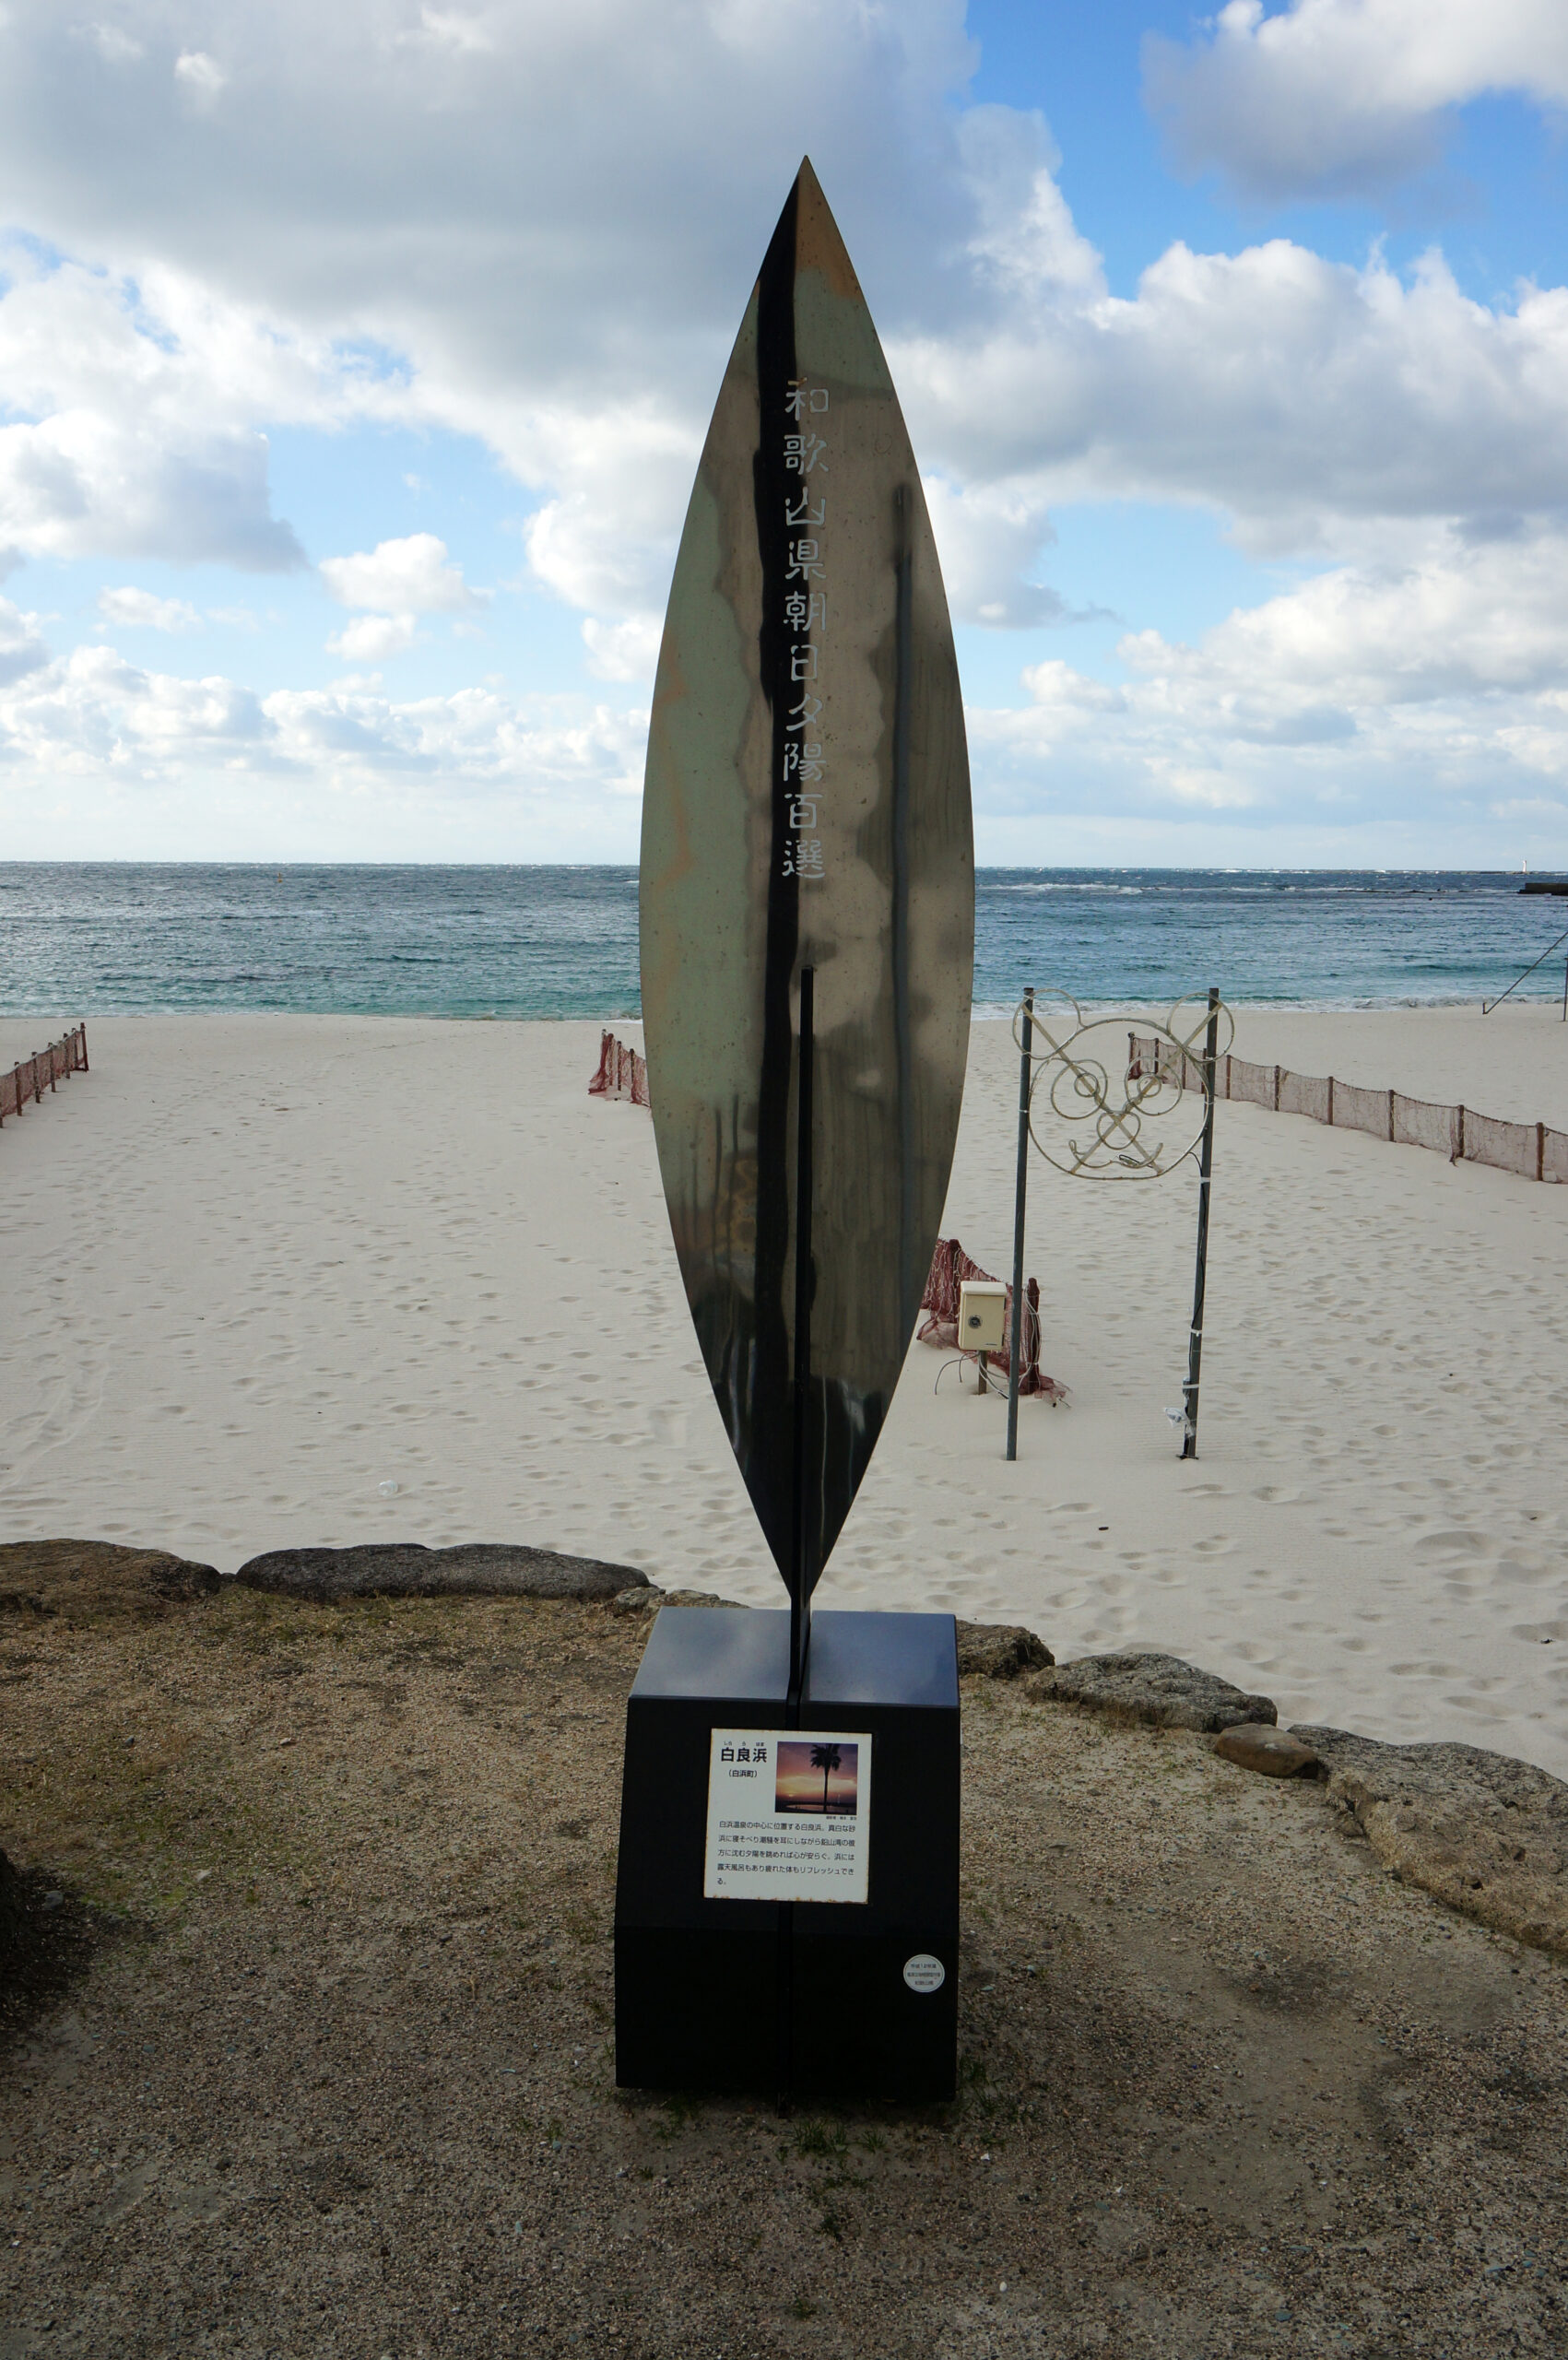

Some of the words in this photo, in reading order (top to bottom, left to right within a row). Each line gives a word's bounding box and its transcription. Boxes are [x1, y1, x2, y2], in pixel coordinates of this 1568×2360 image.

[783, 376, 830, 879] 和歌山県朝日夕陽百選
[721, 1747, 767, 1763] 白良浜
